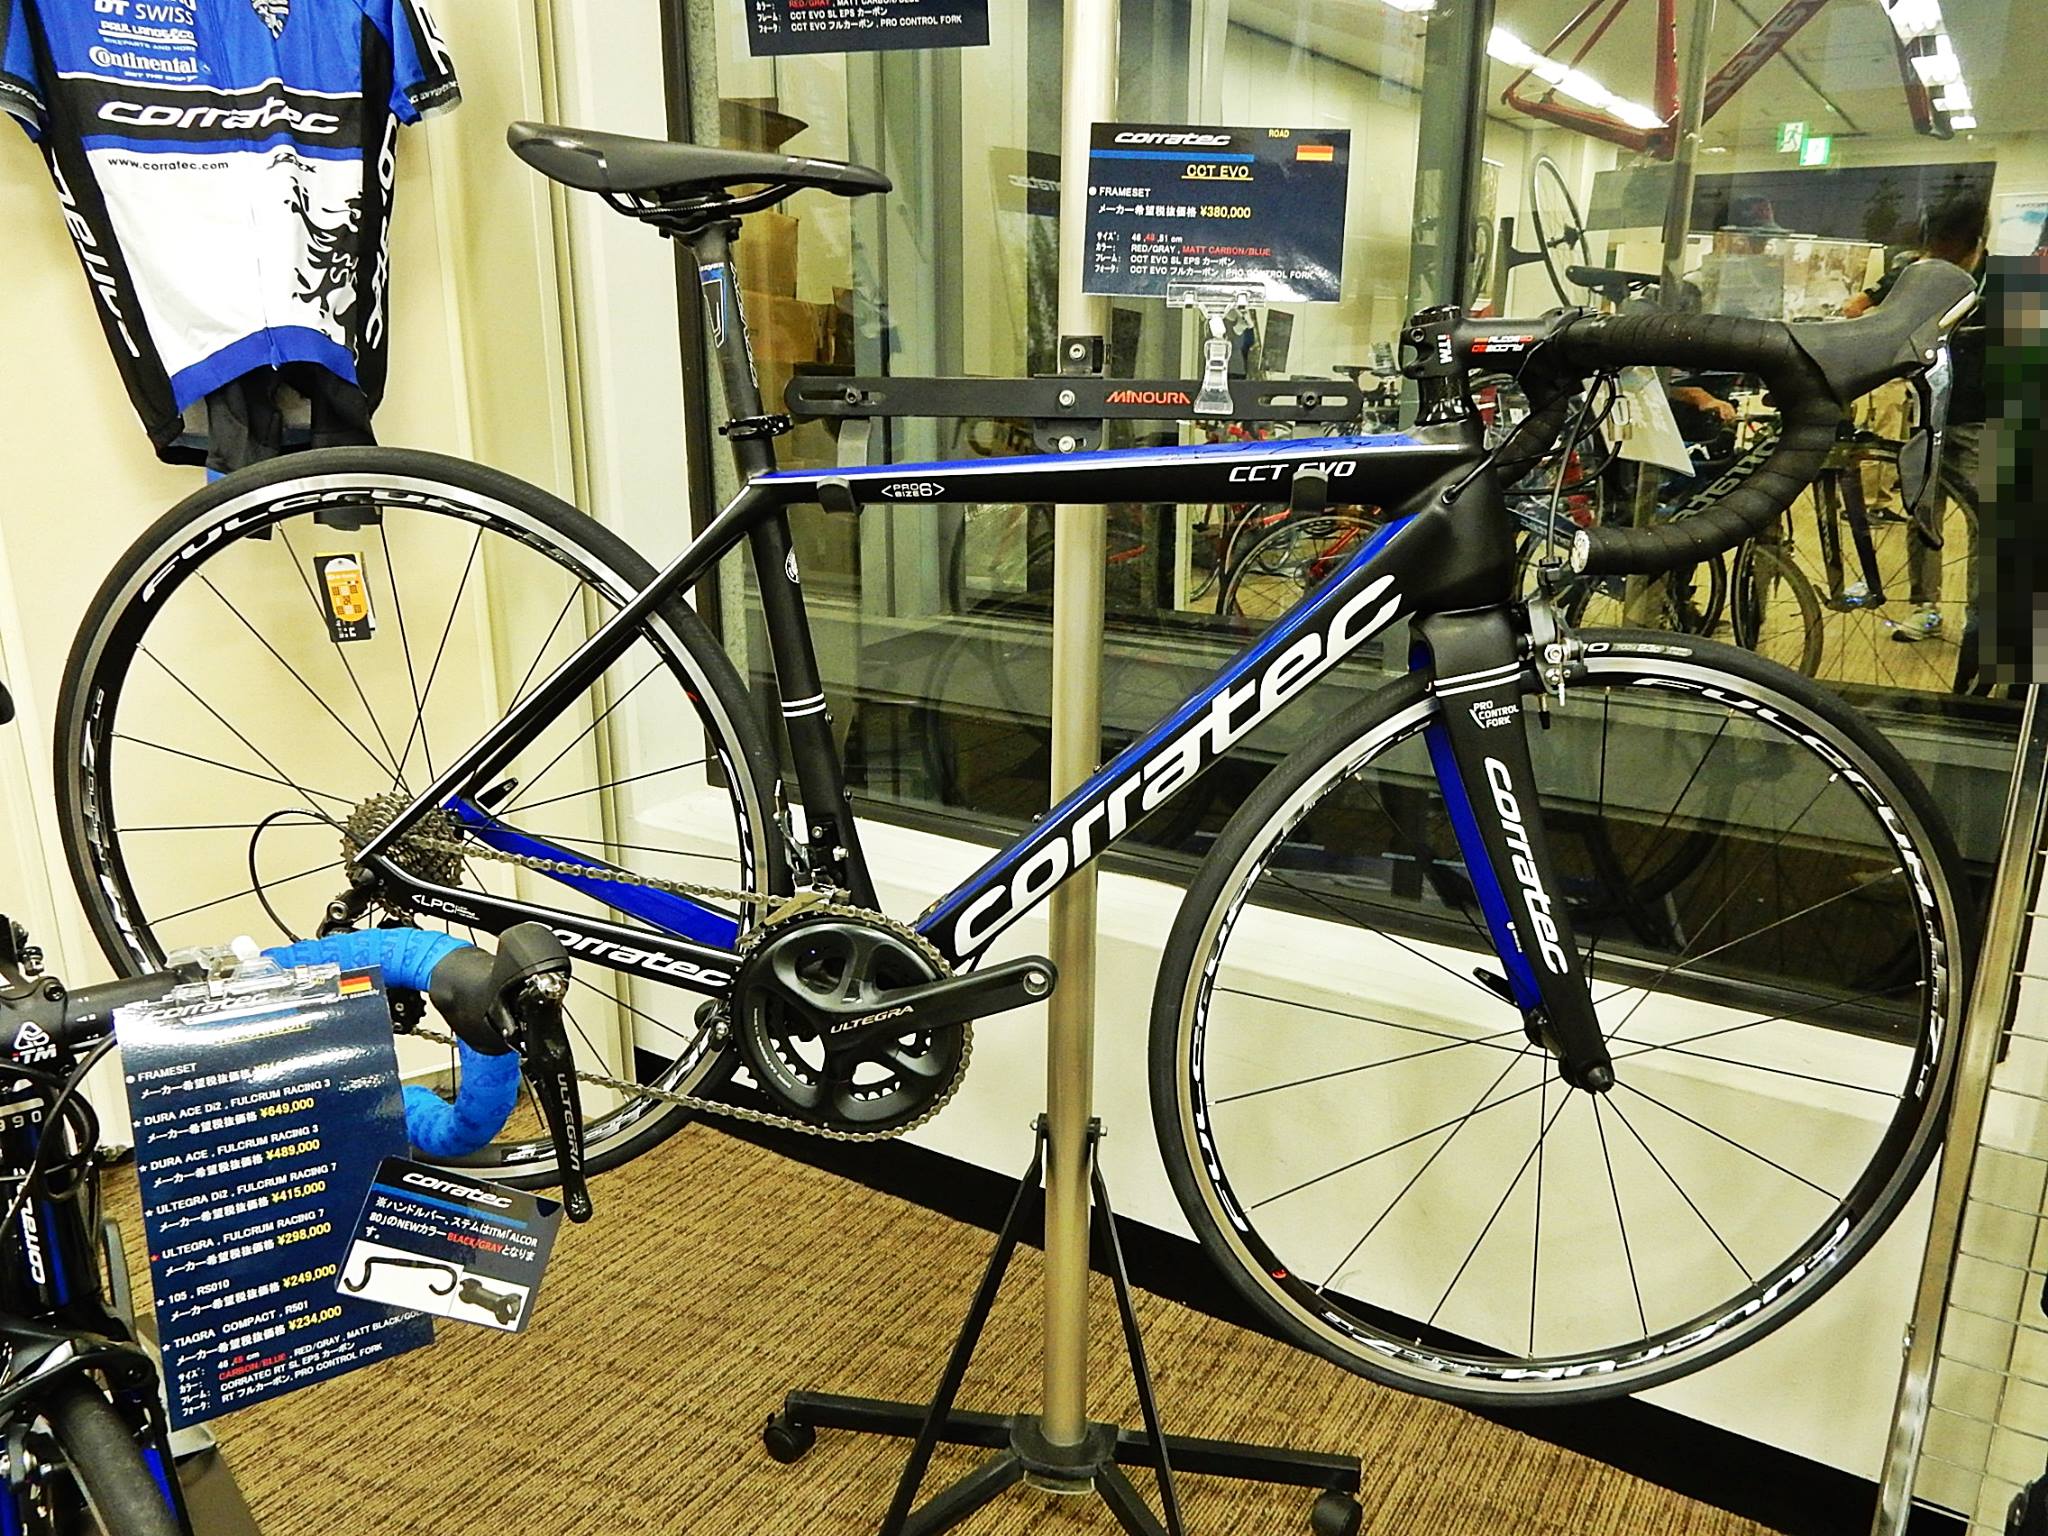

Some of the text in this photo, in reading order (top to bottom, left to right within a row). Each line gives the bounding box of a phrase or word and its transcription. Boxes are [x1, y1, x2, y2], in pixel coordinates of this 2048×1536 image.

[135, 4, 194, 26] SWISS
[809, 10, 825, 19] EVO
[828, 10, 838, 19] SL
[840, 9, 855, 18] EPS
[810, 21, 826, 31] EVO
[880, 18, 897, 27] PRO
[900, 16, 938, 26] CONTROL
[940, 14, 962, 24] FORK
[89, 46, 198, 74] Continental
[97, 97, 340, 134] corratec
[1114, 131, 1232, 147] corratec
[1268, 129, 1290, 139] ROAD
[107, 155, 229, 172] www.corratec.com
[1186, 164, 1250, 179] CCT EVO
[1099, 186, 1151, 198] FRAMESET
[1200, 205, 1251, 220] ¥380,000
[1131, 244, 1273, 257] RED/GRAY MATT CARBON/BLUE
[1151, 255, 1168, 265] EVO
[1170, 256, 1182, 265] SL
[1183, 256, 1200, 266] EPS
[1150, 266, 1168, 275] EVO
[1290, 270, 1314, 280] FORK
[1105, 389, 1192, 405] MINOURA
[1228, 463, 1290, 482] CCT
[892, 483, 919, 491] PRO
[919, 482, 933, 497] 6
[143, 489, 492, 602] FULCRUM
[1473, 700, 1494, 712] PRO
[1478, 704, 1520, 720] CONTROL
[1485, 714, 1511, 728] FORK
[954, 575, 1404, 958] corratec
[1633, 678, 1934, 907] FULCRUM
[1484, 757, 1569, 975] corratec
[421, 894, 456, 913] LPC
[548, 925, 732, 987] orratec
[830, 1005, 914, 1034] ULTEGRA
[137, 1063, 197, 1082] FRAMESET
[144, 1111, 177, 1126] DURA
[179, 1105, 202, 1119] ACE
[230, 1089, 281, 1108] FULCRUM
[283, 1080, 323, 1096] RACING
[324, 1078, 331, 1088] 3
[260, 1097, 315, 1118] ¥649,000
[558, 1073, 581, 1172] ULTEGRA
[150, 1124, 319, 1171] DURA ACE FULCRUM RACING 3
[265, 1138, 321, 1161] ¥489,000
[155, 1195, 209, 1215] ULTEGRA
[237, 1174, 288, 1195] FULCRUM
[289, 1164, 329, 1182] RACING
[330, 1162, 338, 1172] 7
[271, 1180, 327, 1203] ¥415,000
[402, 1172, 513, 1209] corratec
[161, 1208, 325, 1260] ULTEGRA FULCRUM RACING 7
[276, 1222, 332, 1246] ¥298,000
[365, 1225, 381, 1240] す。
[282, 1263, 337, 1289] ¥249,000
[168, 1292, 188, 1305] 105
[288, 1305, 343, 1331] ¥234,000
[173, 1328, 216, 1350] TIAGRA
[222, 1309, 277, 1334] COMPACT
[218, 1352, 288, 1381] CARBON/BLUE
[293, 1334, 341, 1357] RED/GRAY
[346, 1324, 370, 1340] MATT
[246, 1352, 261, 1361] cm
[220, 1369, 272, 1392] CORRATEC
[273, 1364, 286, 1374] RT
[288, 1360, 300, 1370] SL
[302, 1353, 321, 1366] EPS
[221, 1392, 235, 1404] RT
[294, 1366, 314, 1380] PRO
[316, 1351, 358, 1372] CONTROL
[359, 1342, 384, 1357] FORK
